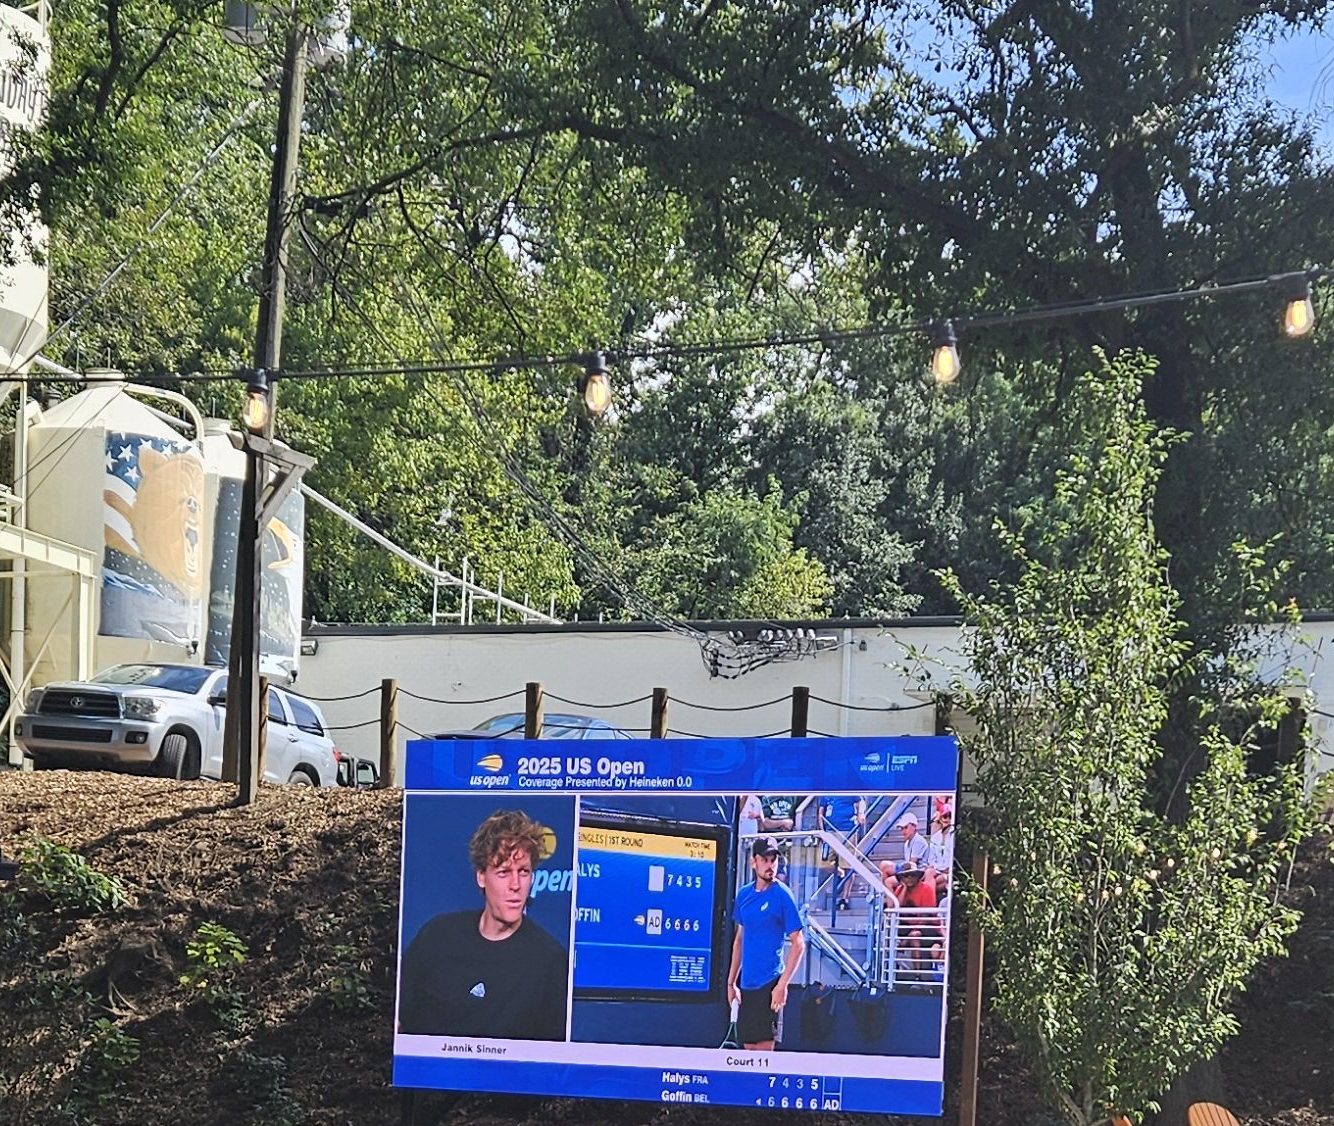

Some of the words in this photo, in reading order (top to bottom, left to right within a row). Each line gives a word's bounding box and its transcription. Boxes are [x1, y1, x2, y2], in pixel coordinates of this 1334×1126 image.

[891, 755, 918, 764] ESPN
[517, 757, 562, 775] 2025
[566, 758, 592, 775] US
[597, 758, 645, 779] Open
[518, 776, 564, 789] Coverage
[565, 776, 613, 788] Presented
[614, 777, 627, 788] by
[629, 776, 675, 788] Heineken
[676, 777, 693, 788] 0.0
[621, 837, 644, 848] ROUND
[530, 869, 575, 899] pen
[667, 874, 674, 887] 7
[676, 875, 683, 887] 4
[686, 876, 692, 888] 3
[695, 876, 702, 888] 5
[649, 915, 661, 928] AD
[441, 1043, 474, 1053] Jannik
[476, 1044, 507, 1054] Sinner
[726, 1056, 754, 1067] Court
[758, 1058, 769, 1067] 11
[662, 1071, 690, 1086] Halys
[692, 1075, 709, 1085] FRA
[768, 1076, 777, 1088] 7
[782, 1077, 789, 1088] 4
[796, 1078, 804, 1089] 3
[810, 1078, 819, 1090] 5
[661, 1090, 692, 1103] Goffin
[694, 1094, 710, 1104] BEL
[768, 1096, 775, 1108] 6
[781, 1097, 789, 1108] 6
[795, 1097, 803, 1109] 6
[809, 1098, 818, 1109] 6
[824, 1099, 840, 1110] AD
